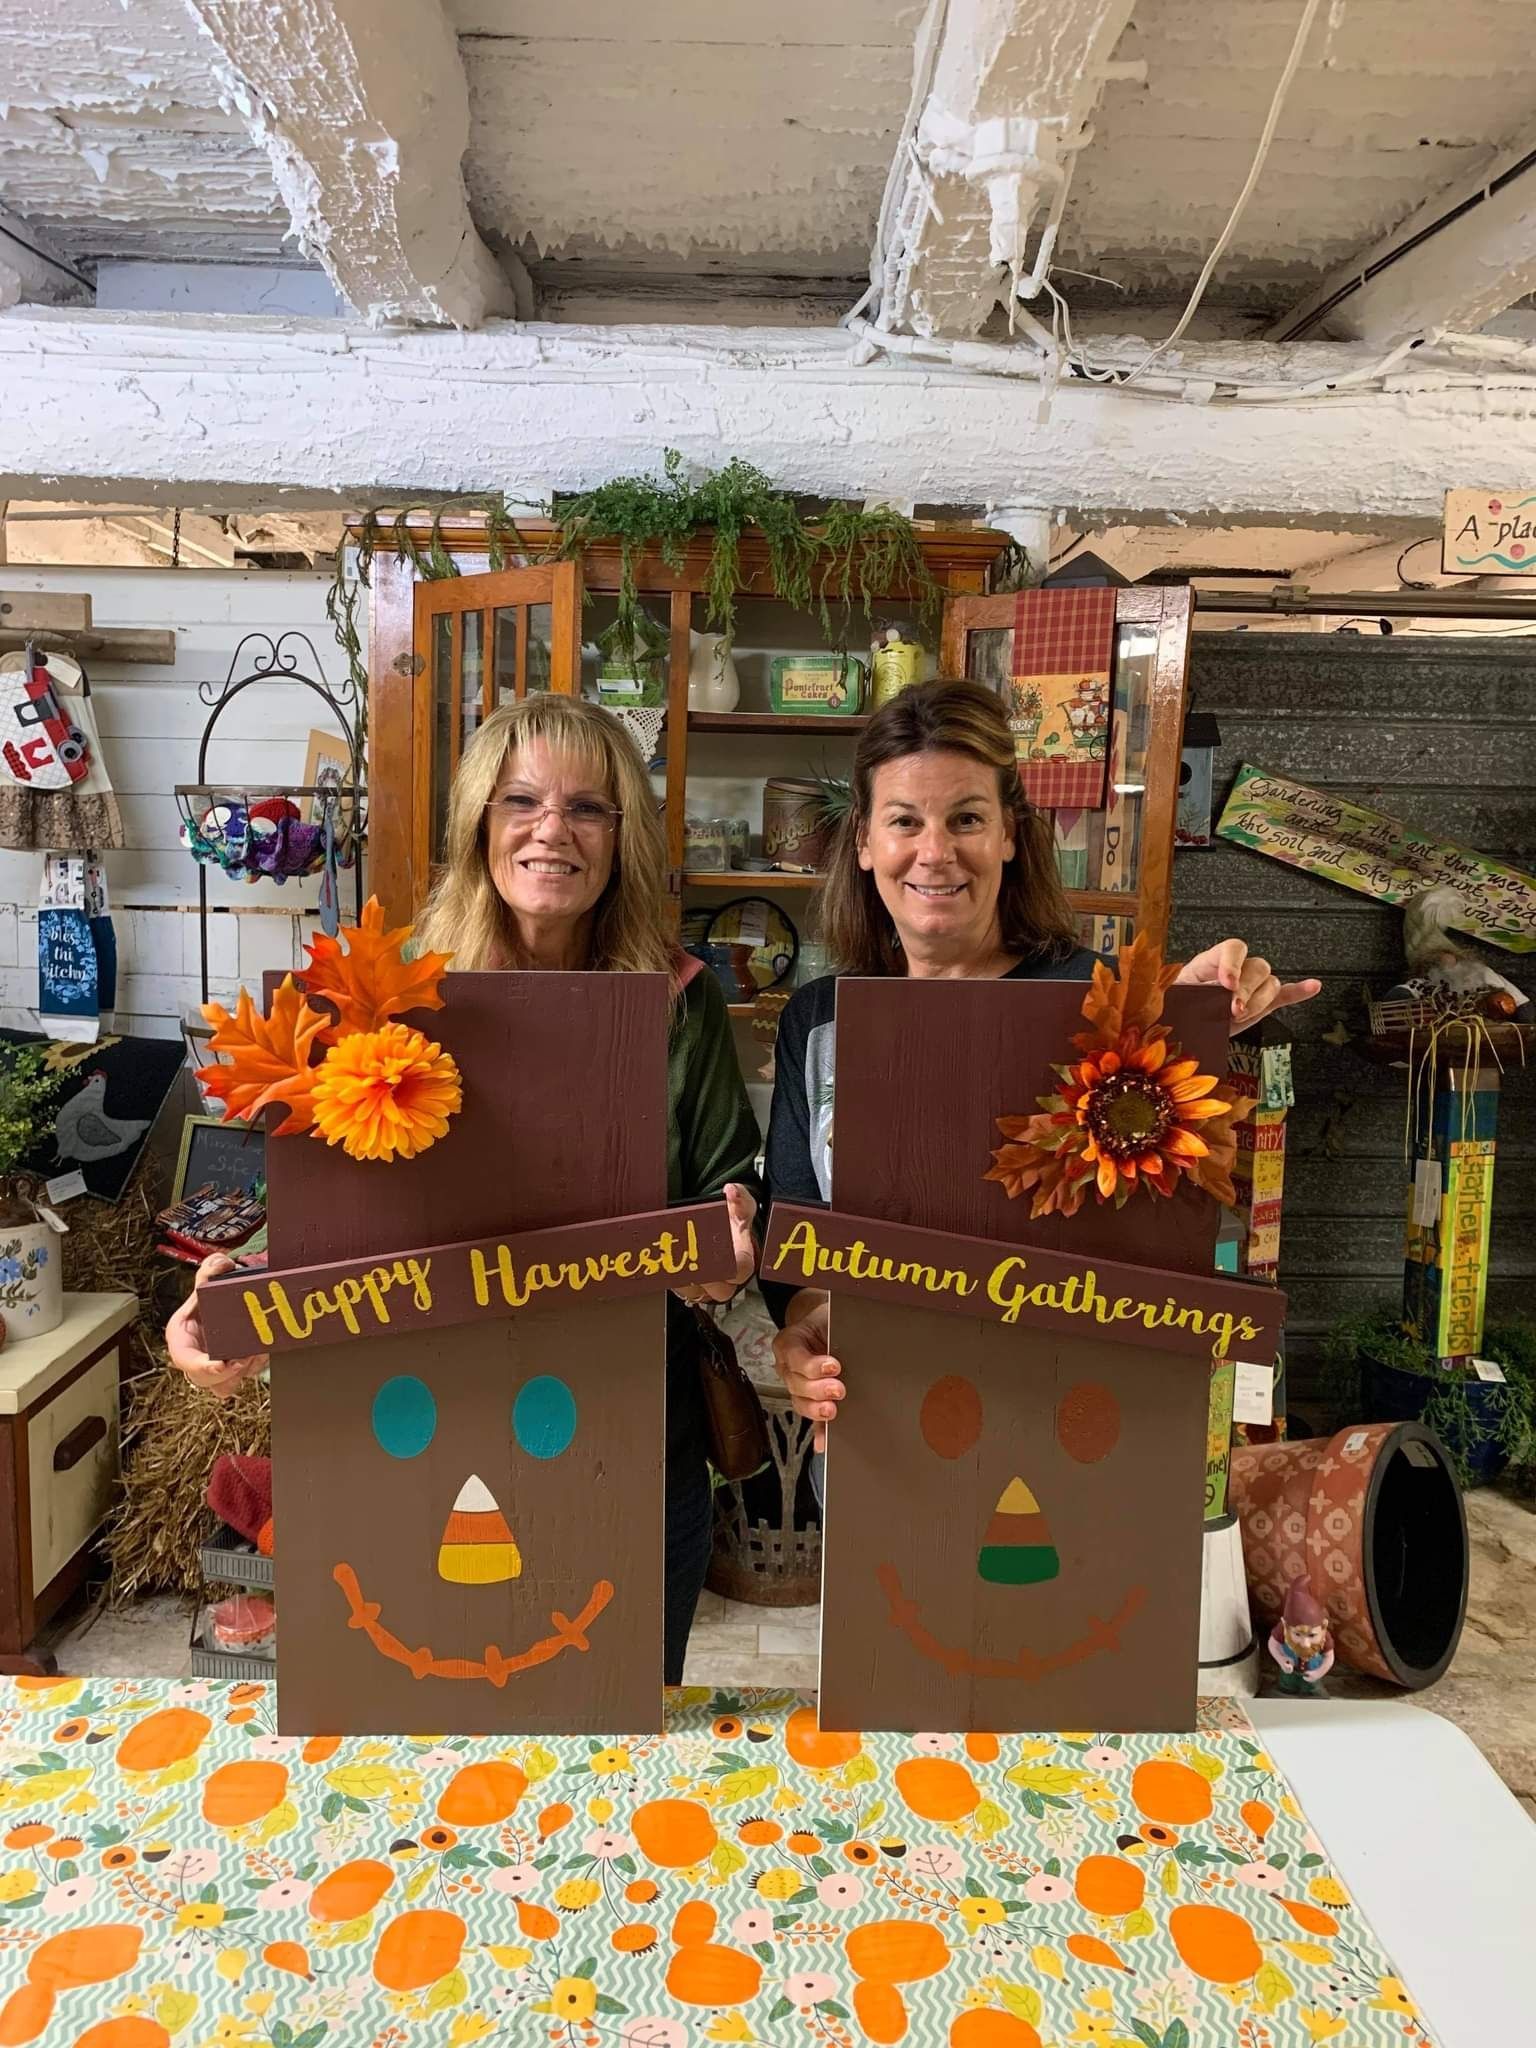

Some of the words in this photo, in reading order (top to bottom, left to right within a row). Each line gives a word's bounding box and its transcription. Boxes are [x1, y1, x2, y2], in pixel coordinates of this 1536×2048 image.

[1455, 514, 1479, 541] A
[1488, 514, 1536, 548] pla
[1234, 812, 1270, 834] the
[1268, 831, 1306, 852] soil
[1307, 845, 1346, 870] and
[1353, 862, 1392, 893] sky
[1242, 777, 1344, 826] Gardening
[1368, 824, 1400, 845] the
[1406, 840, 1439, 861] art
[1444, 853, 1480, 877] that
[1488, 872, 1530, 897] uses
[243, 1256, 431, 1345] Happy
[469, 1219, 699, 1307] Harvest!
[773, 1220, 979, 1297] Autumn
[987, 1256, 1264, 1359] Gatherings
[1447, 1257, 1481, 1350] friends
